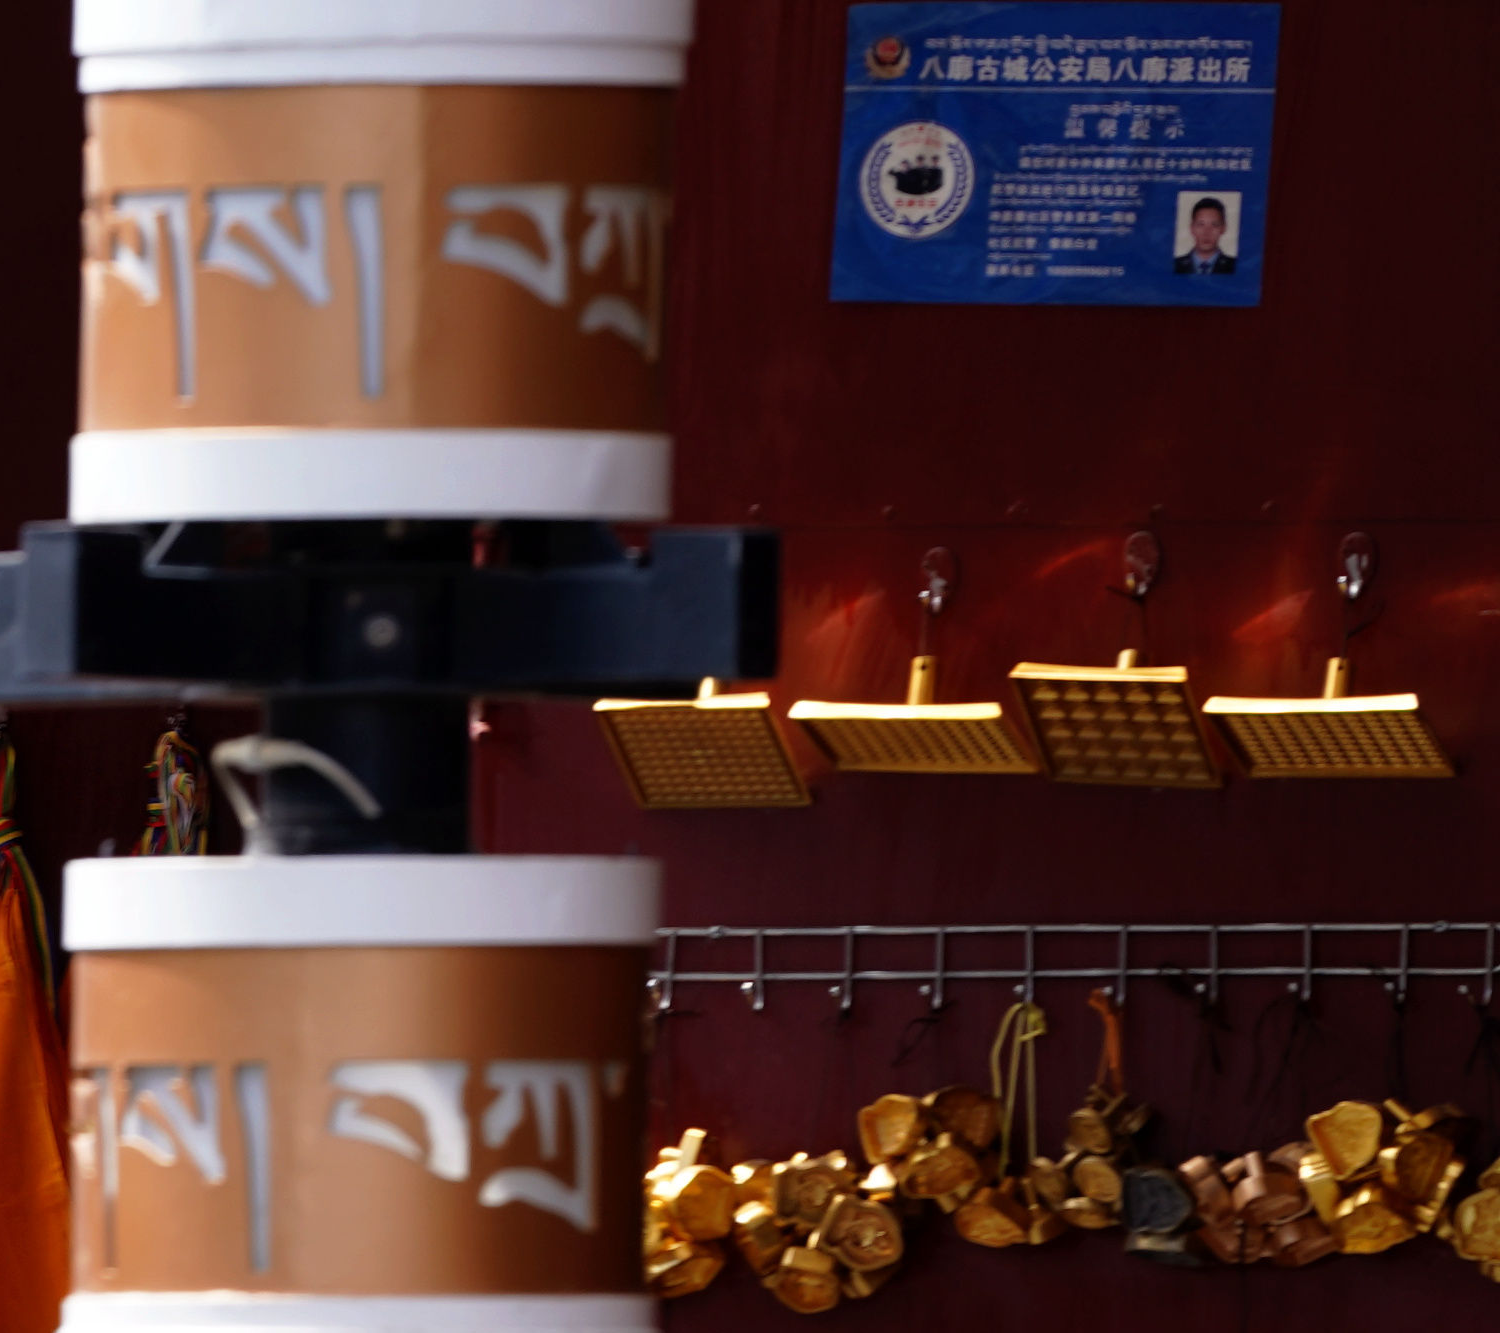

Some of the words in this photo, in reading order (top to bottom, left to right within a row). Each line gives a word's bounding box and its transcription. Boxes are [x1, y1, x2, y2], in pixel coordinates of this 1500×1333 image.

[919, 55, 1251, 83] 八廓古城公安局八廓派出所
